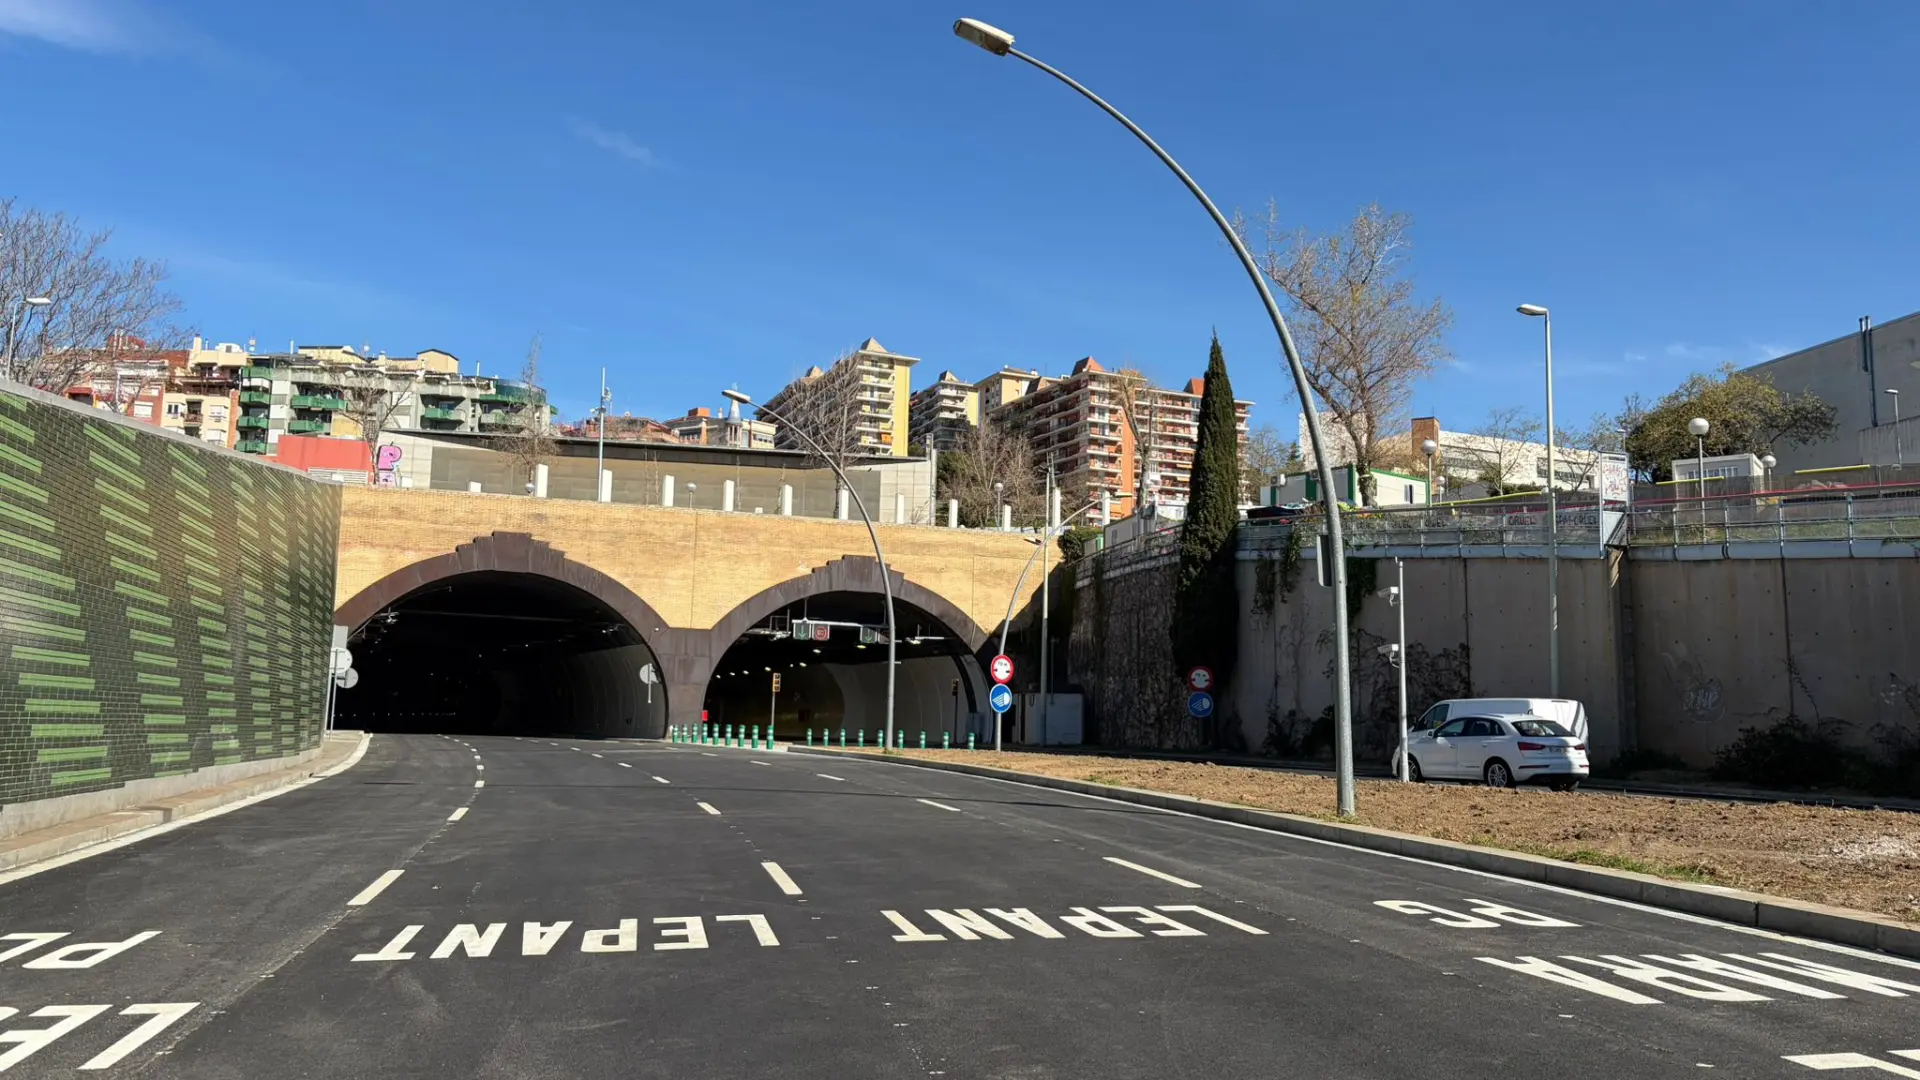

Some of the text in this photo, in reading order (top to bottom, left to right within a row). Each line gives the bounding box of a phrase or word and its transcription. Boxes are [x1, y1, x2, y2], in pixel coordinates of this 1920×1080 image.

[351, 914, 780, 961] LEPANT
[881, 906, 1269, 941] LEPANT
[0, 1002, 200, 1072] LE
